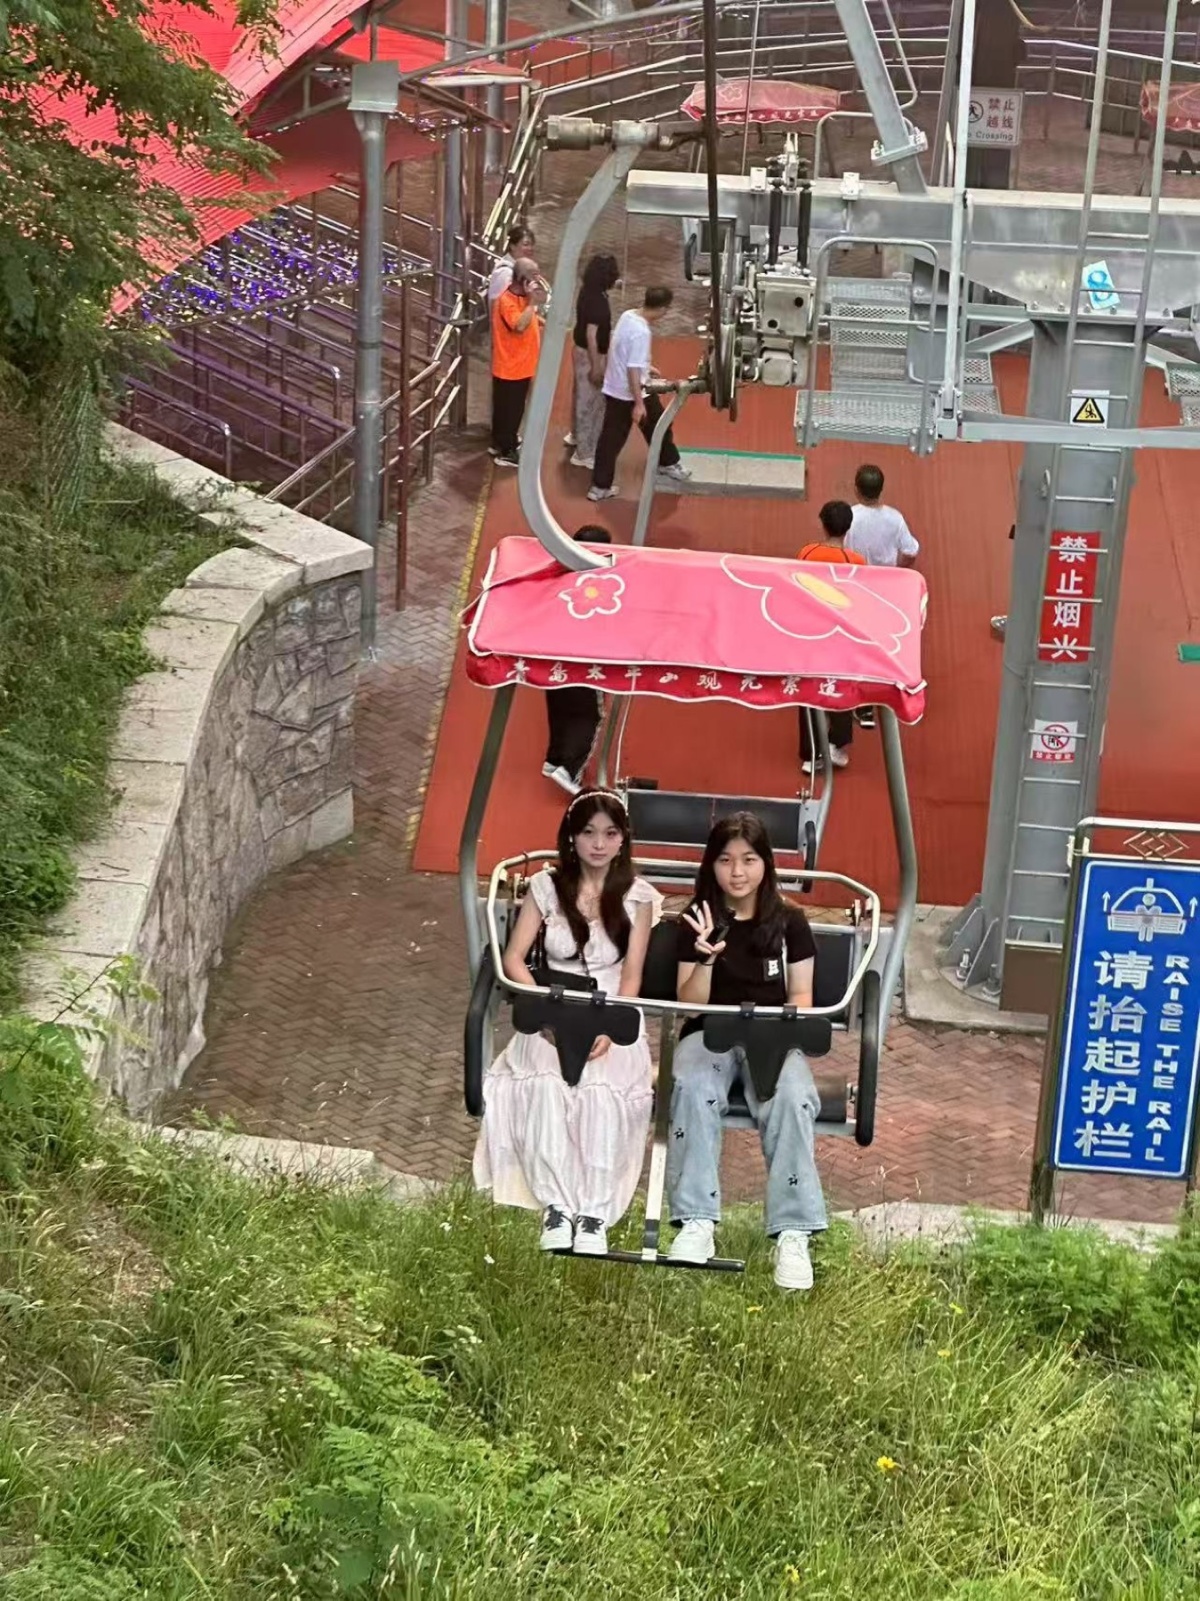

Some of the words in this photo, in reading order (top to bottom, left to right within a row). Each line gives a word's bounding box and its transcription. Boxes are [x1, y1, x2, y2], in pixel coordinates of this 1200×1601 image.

[988, 98, 1015, 111] 禁止
[975, 131, 1013, 141] Crossing
[1051, 536, 1087, 660] 禁止烟火
[1162, 955, 1189, 1032] RAISE
[1074, 951, 1153, 1158] 请抬起护栏
[1153, 1043, 1180, 1089] THE
[1144, 1101, 1172, 1162] RAIL
